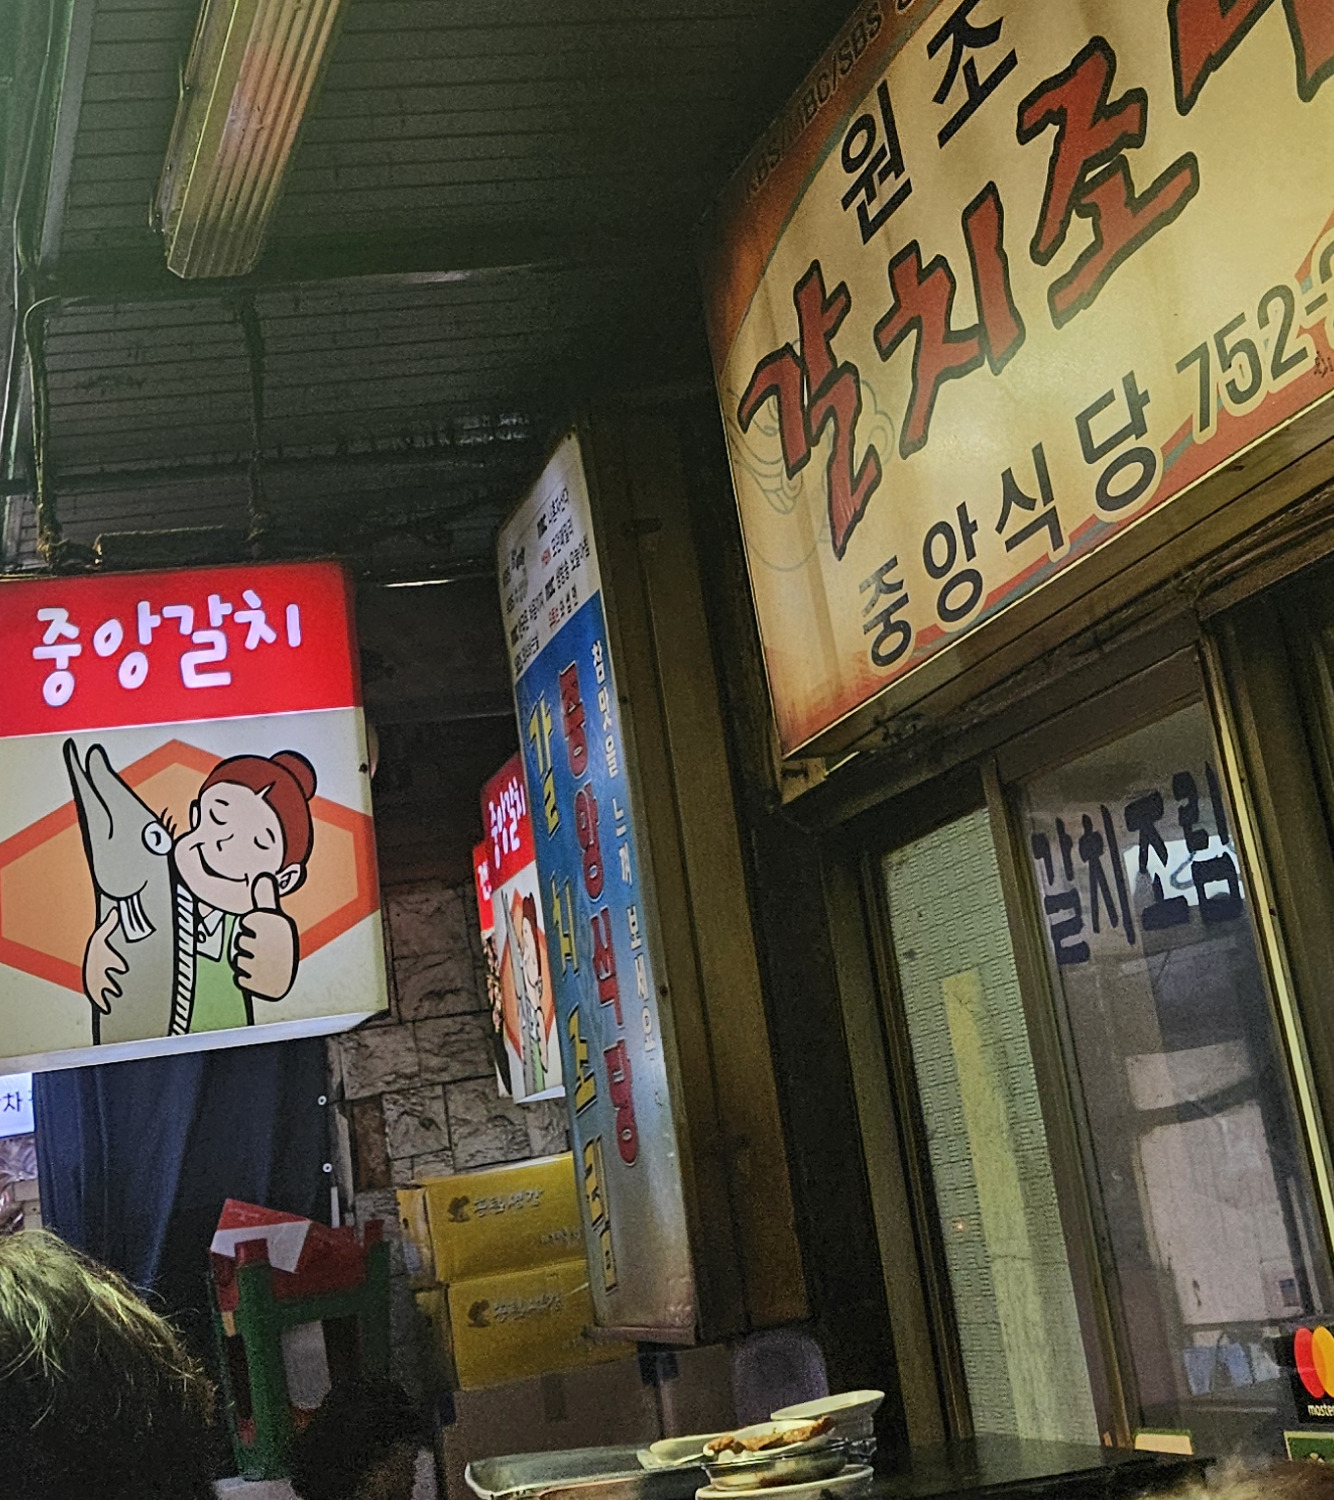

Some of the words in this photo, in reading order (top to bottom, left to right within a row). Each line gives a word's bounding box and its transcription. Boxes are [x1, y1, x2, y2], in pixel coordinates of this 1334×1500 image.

[856, 368, 1158, 669] 중앙식당
[31, 589, 304, 706] 중앙갈치
[488, 776, 527, 870] 중앙갈치
[1030, 760, 1246, 966] 갈치조림
